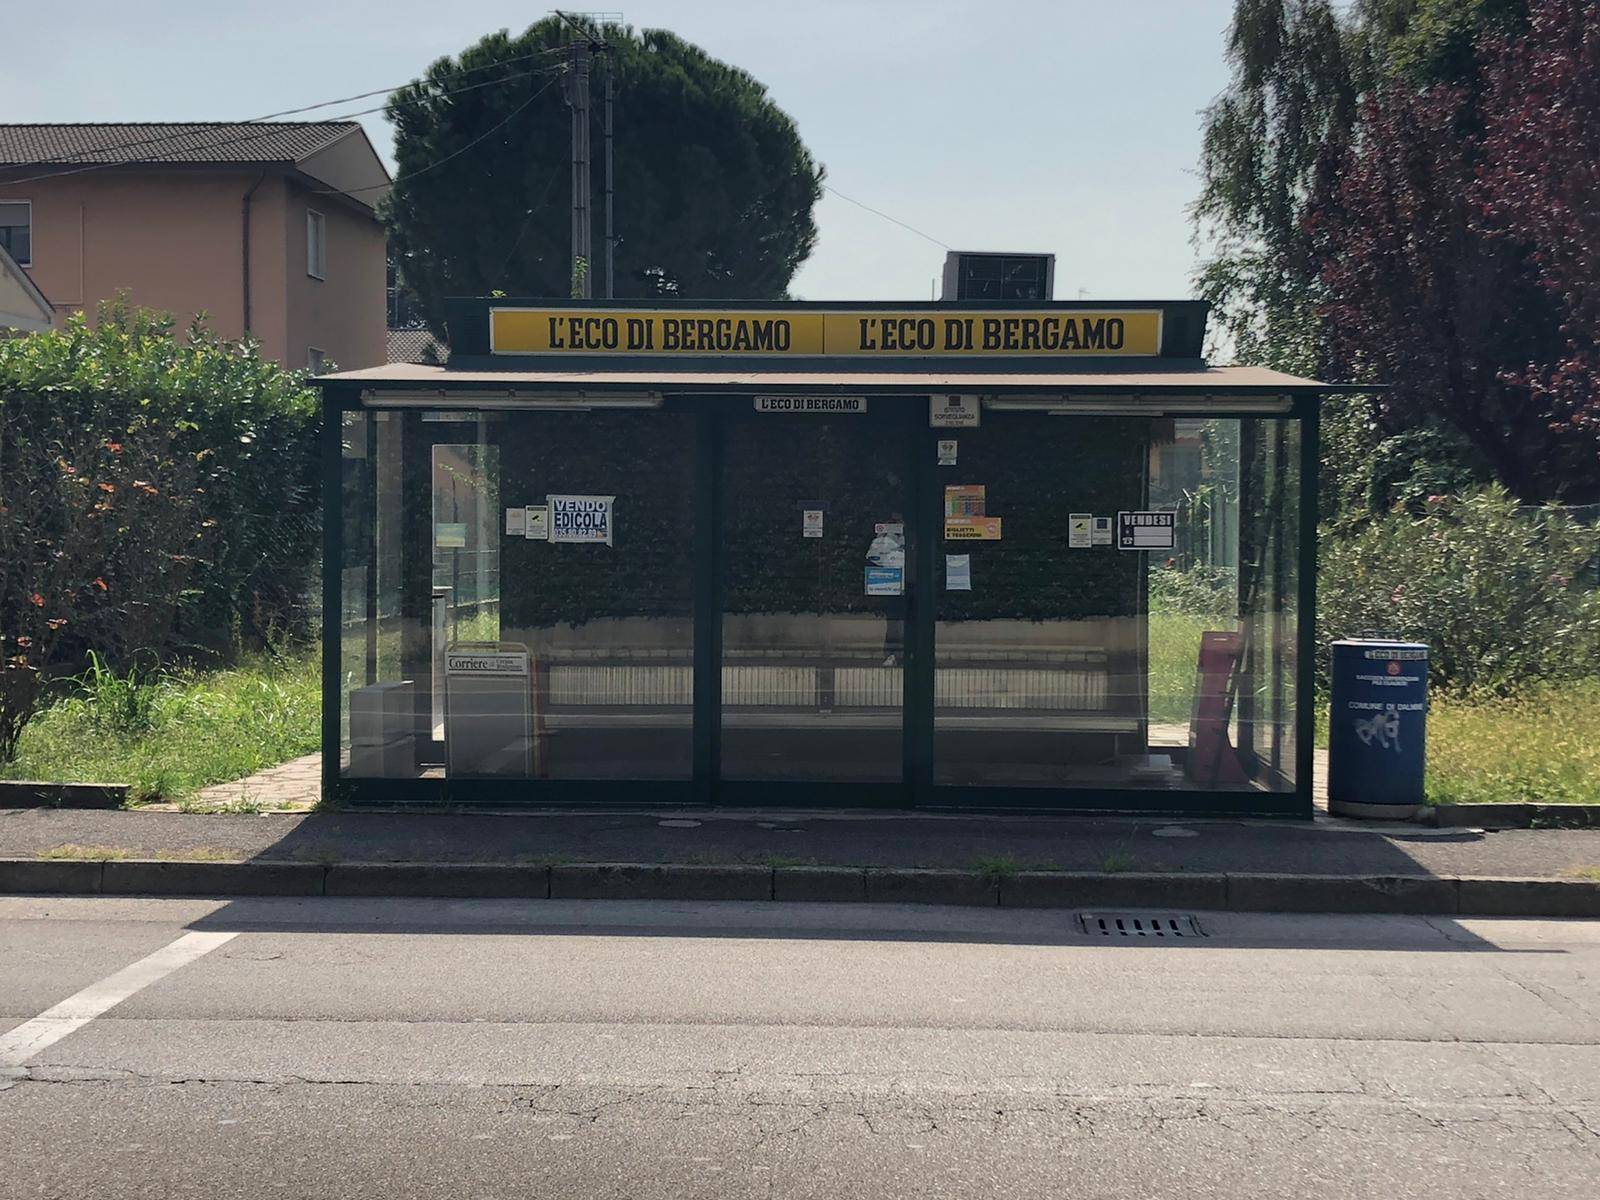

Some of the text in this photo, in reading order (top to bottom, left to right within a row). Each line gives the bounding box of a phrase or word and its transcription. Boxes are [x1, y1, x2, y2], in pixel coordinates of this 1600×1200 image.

[548, 317, 791, 352] L'ECO DI BERGAMO
[858, 317, 1125, 351] L'ECO DI BERGAMO
[761, 398, 860, 410] L'ECO DI BERGAMO
[555, 500, 606, 511] VENDO
[554, 513, 607, 528] EDICOLA
[1124, 515, 1171, 526] VENDESI
[448, 658, 488, 669] Corriere
